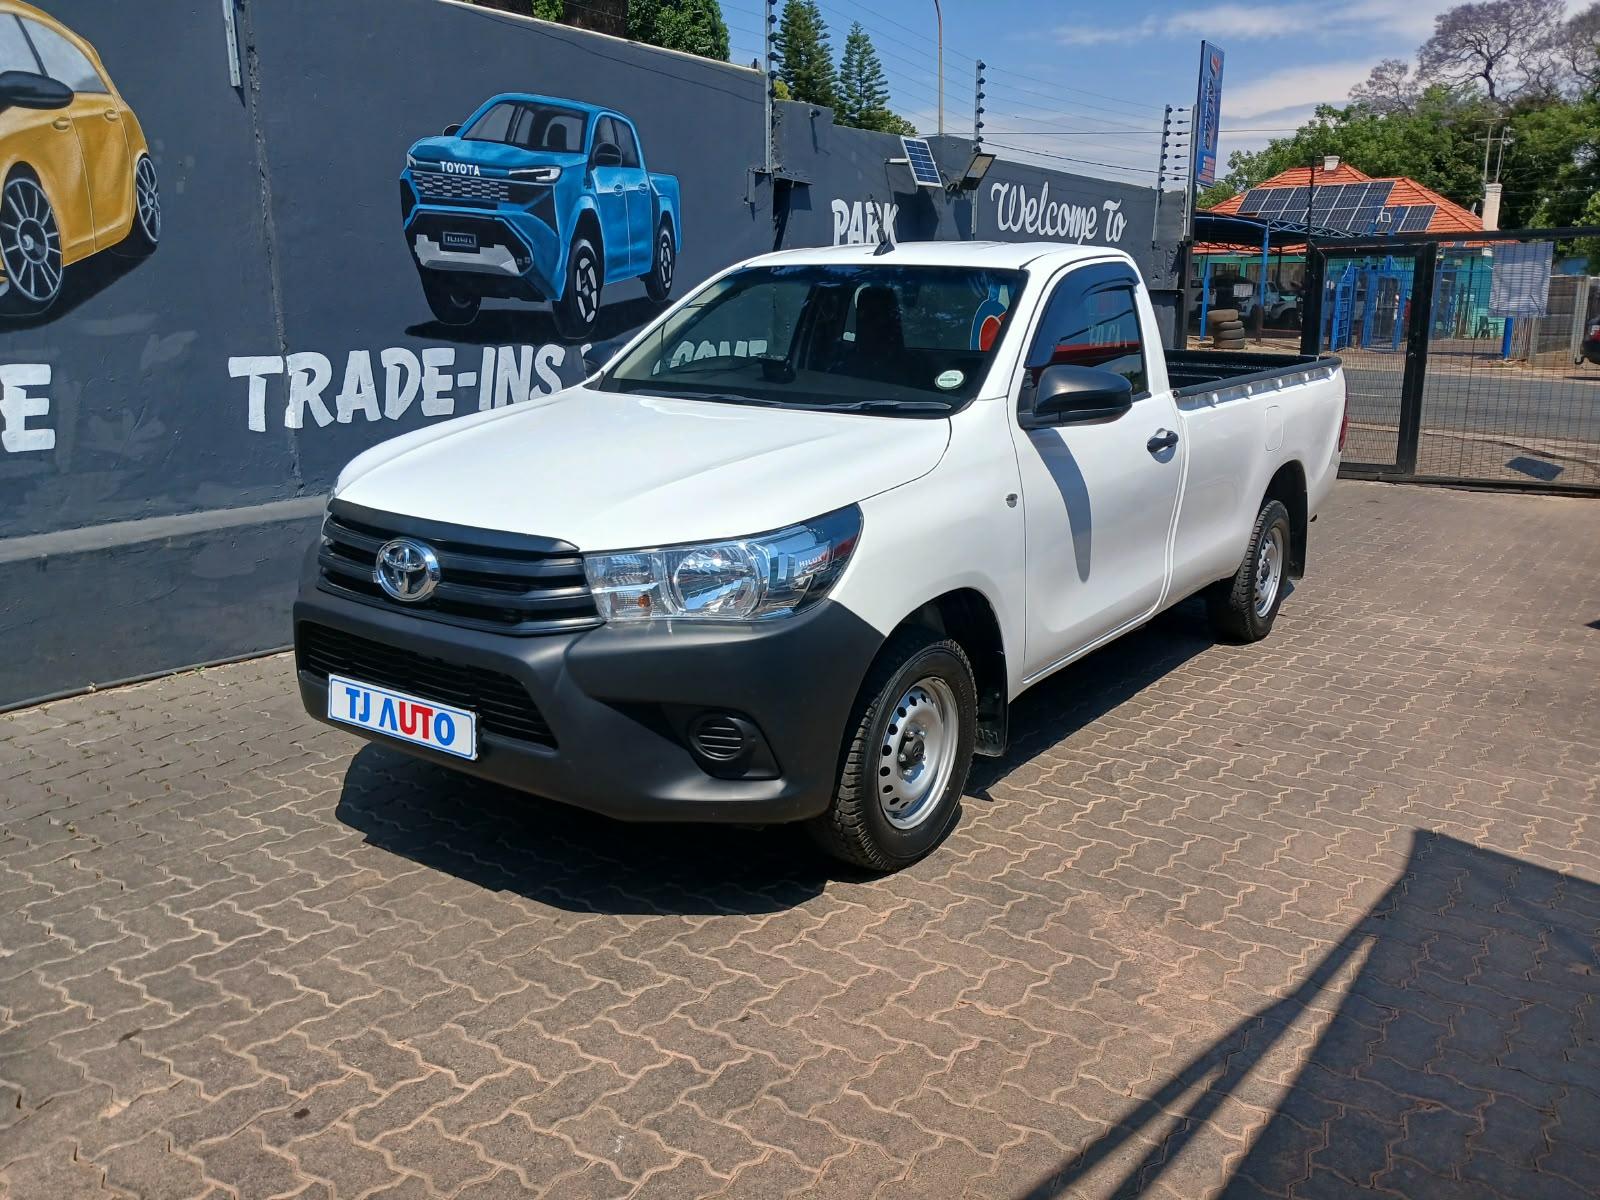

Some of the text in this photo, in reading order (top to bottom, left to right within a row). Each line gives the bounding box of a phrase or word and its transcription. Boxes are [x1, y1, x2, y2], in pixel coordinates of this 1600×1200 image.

[440, 161, 480, 176] TOYOTA
[832, 199, 899, 246] PARK
[991, 181, 1127, 245] Welcome To
[228, 344, 566, 432] TRADE-INS
[799, 556, 823, 568] HILUX
[345, 687, 456, 747] TJ AUTO
